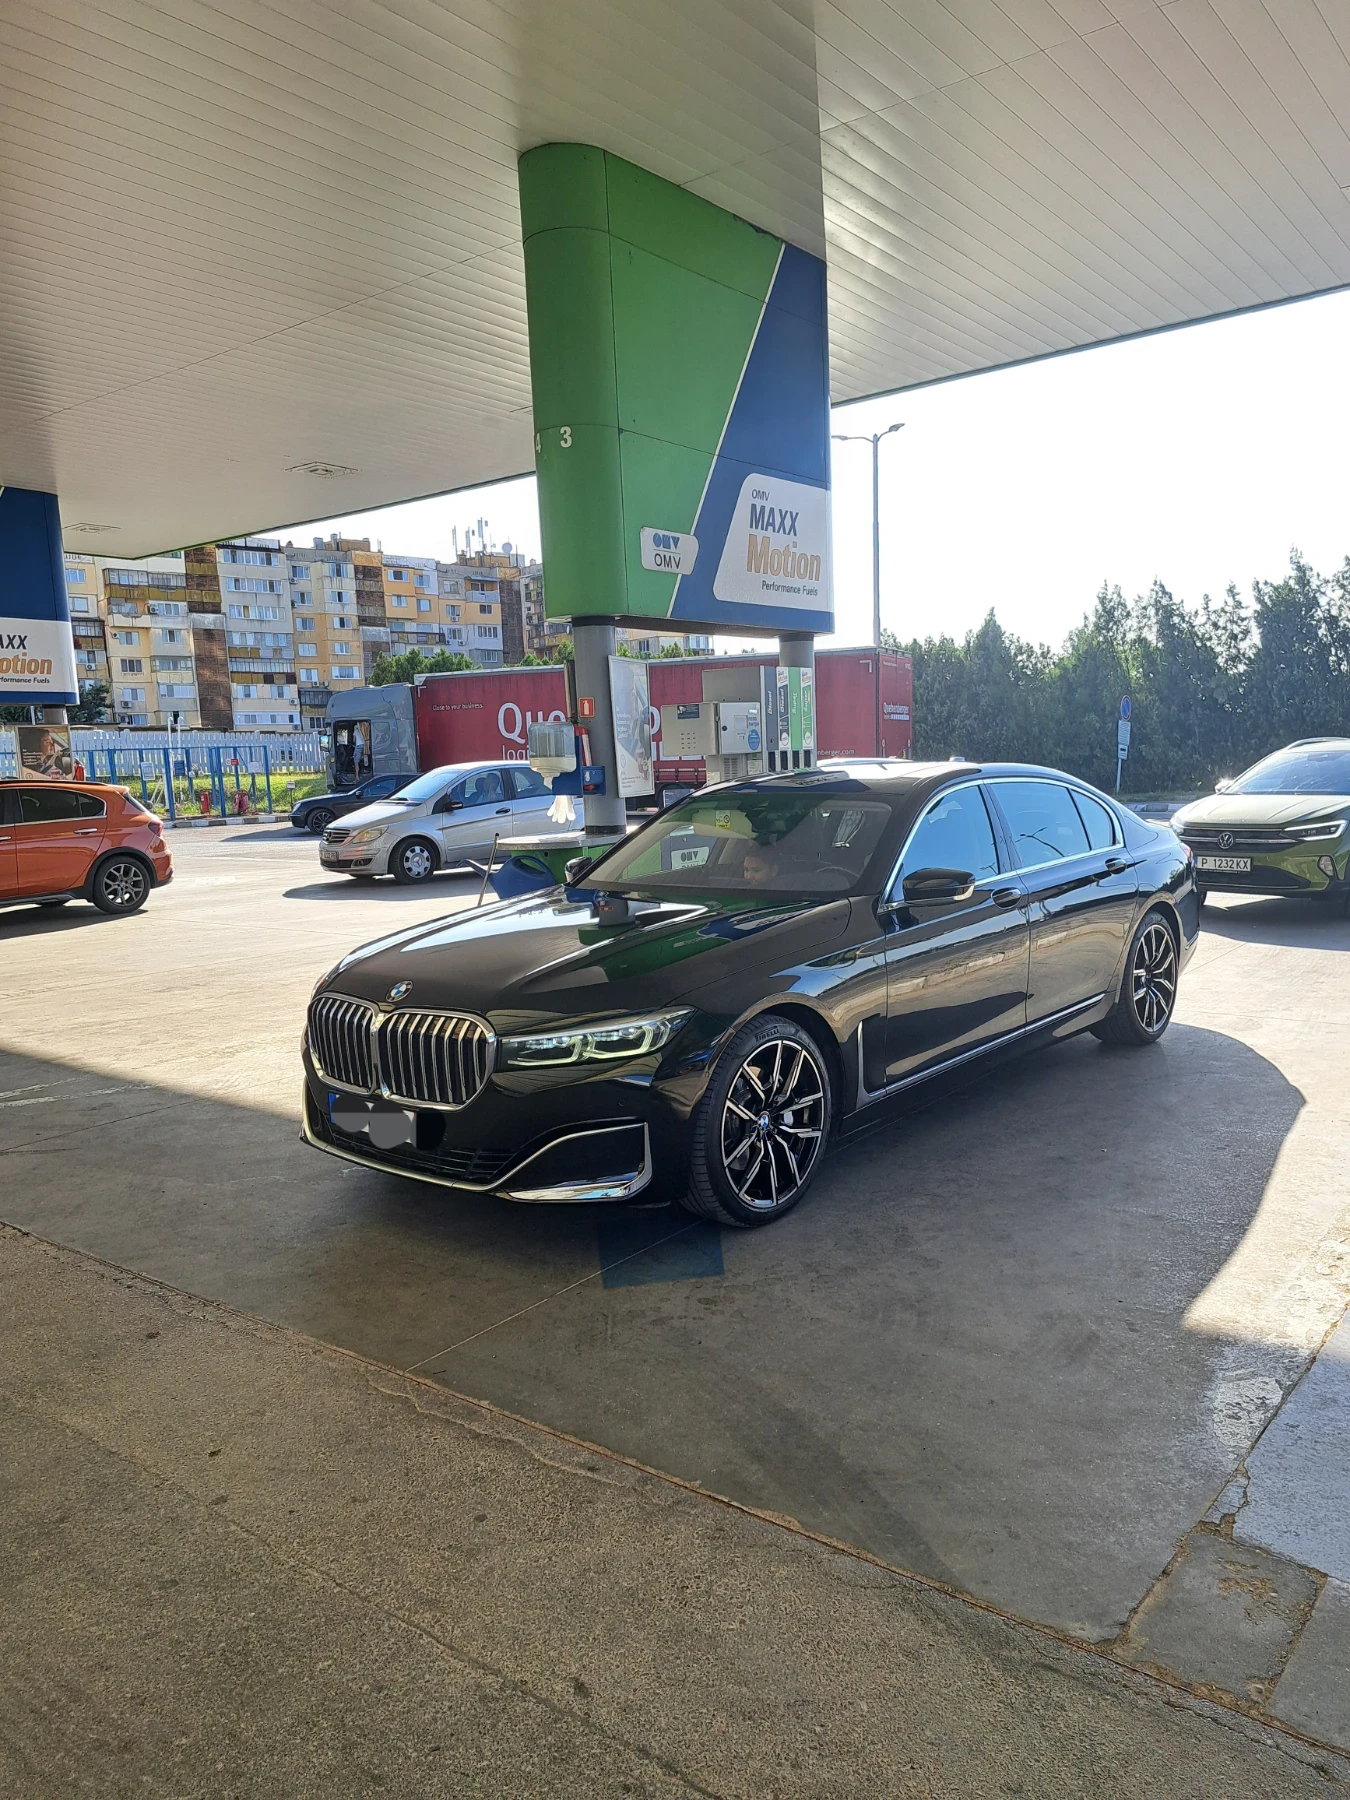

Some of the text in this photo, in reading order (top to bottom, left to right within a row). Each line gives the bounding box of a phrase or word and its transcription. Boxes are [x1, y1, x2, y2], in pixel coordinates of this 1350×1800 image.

[560, 426, 572, 448] 3
[751, 488, 770, 501] OMV
[749, 503, 799, 537] MAXX
[654, 553, 681, 570] OMV
[746, 533, 821, 582] Motion
[761, 579, 818, 597] Performance Fuels
[1201, 857, 1208, 868] P
